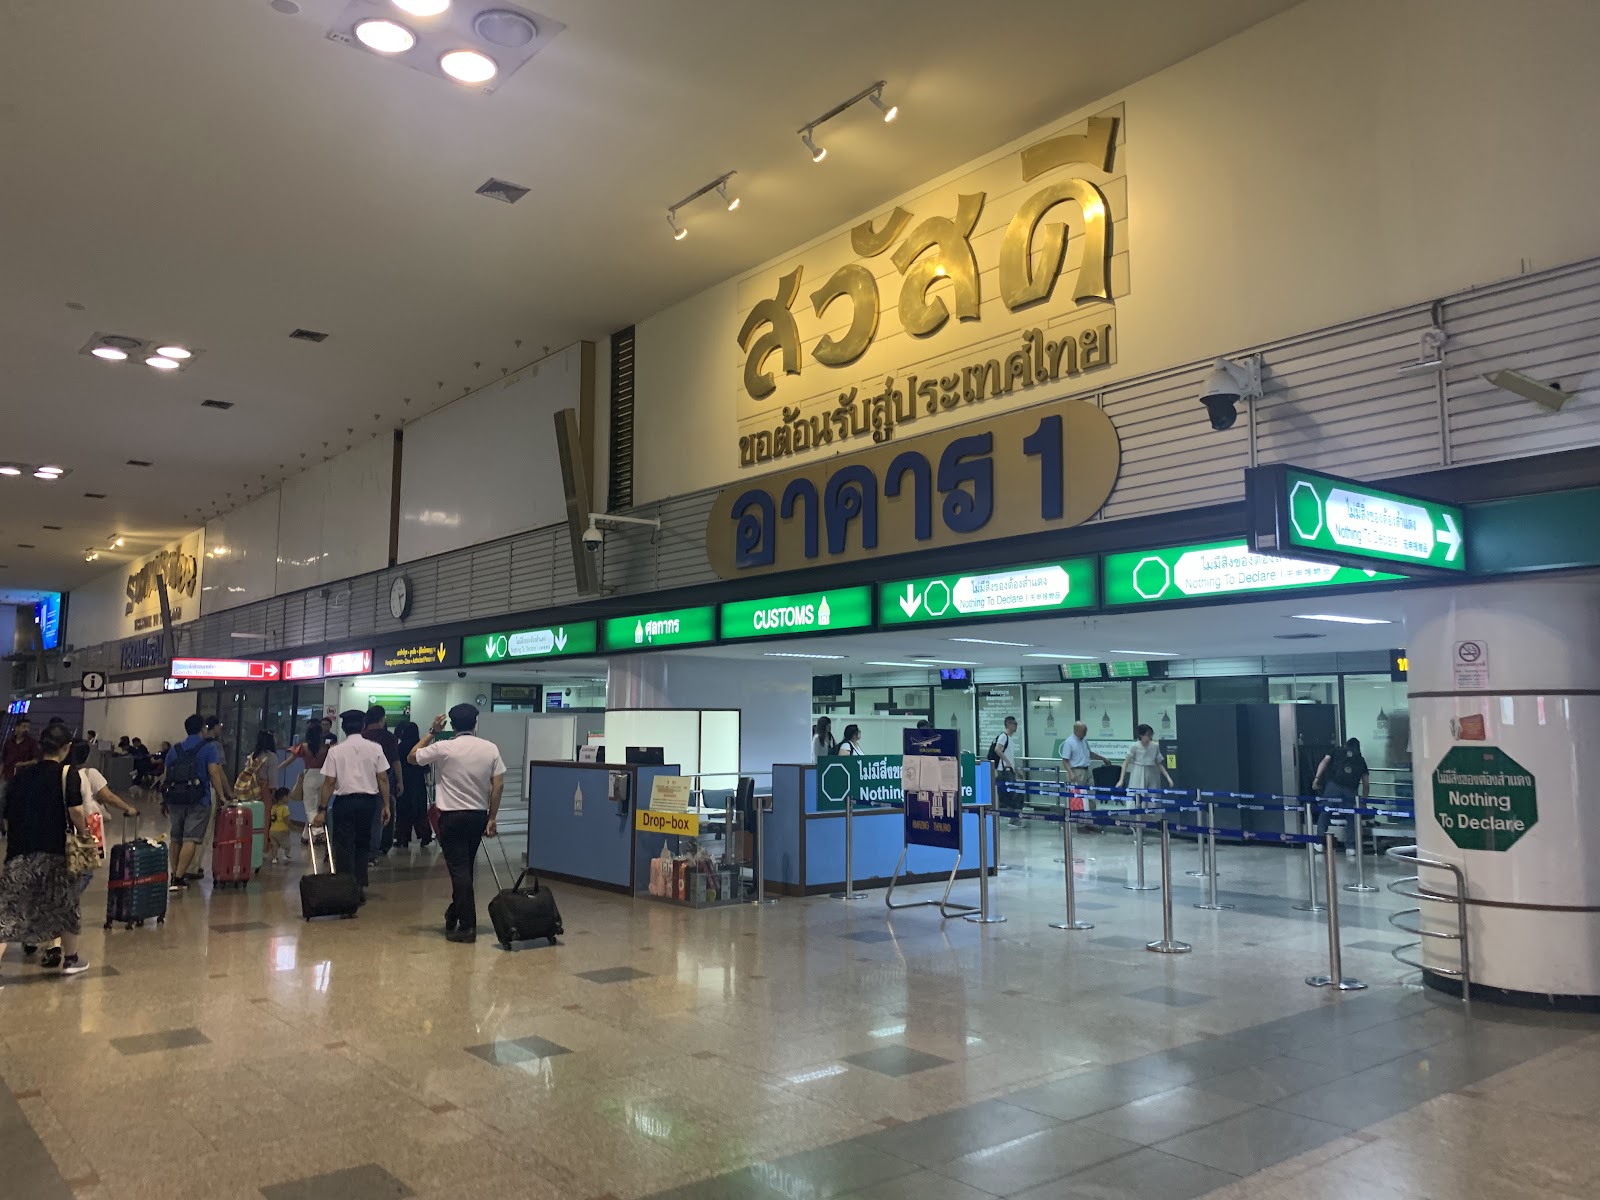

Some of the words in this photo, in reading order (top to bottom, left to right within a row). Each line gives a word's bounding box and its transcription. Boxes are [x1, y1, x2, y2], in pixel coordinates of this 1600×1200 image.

[737, 116, 1120, 402] สวัสดี
[738, 322, 1113, 468] ขอต้อนรับสู่ประเทศไทย
[1022, 414, 1064, 520] 1
[731, 430, 994, 570] อาคาร
[1185, 578, 1221, 590] Nothing
[1224, 573, 1235, 585] To
[1238, 569, 1276, 584] Declare
[959, 597, 985, 609] Nothing
[986, 595, 995, 606] To
[996, 593, 1024, 605] Declare
[753, 604, 815, 630] CUSTOMS
[645, 618, 680, 644] ศุลกากร
[1448, 790, 1511, 812] Nothing
[642, 812, 689, 831] Drop-box
[1438, 812, 1454, 829] To
[1457, 813, 1525, 832] Declare
